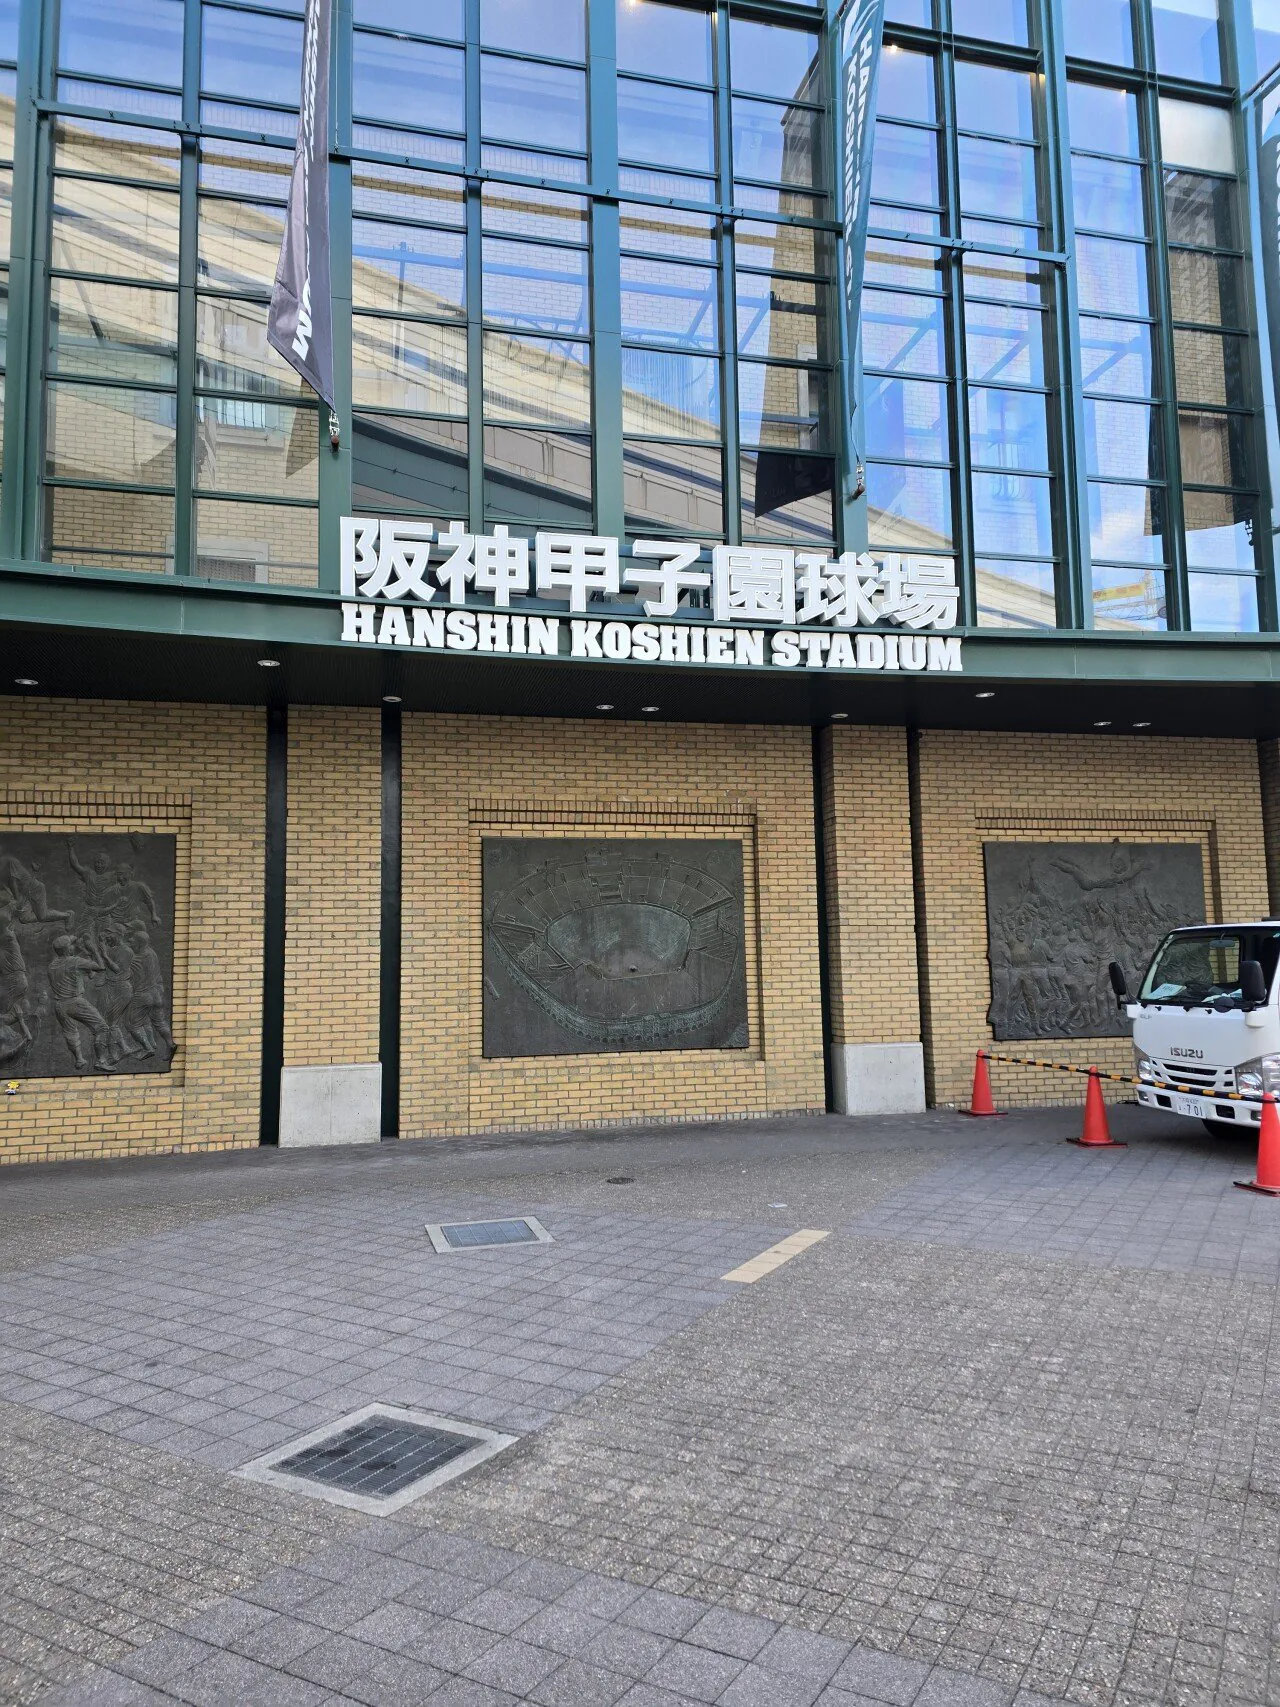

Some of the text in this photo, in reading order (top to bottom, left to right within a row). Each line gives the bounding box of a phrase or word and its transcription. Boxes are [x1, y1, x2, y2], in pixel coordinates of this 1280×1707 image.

[339, 516, 960, 630] 阪神甲子園球場
[341, 602, 963, 672] HANSHIN KOSHIEN STADIUM
[1170, 1046, 1204, 1059] ISUZU
